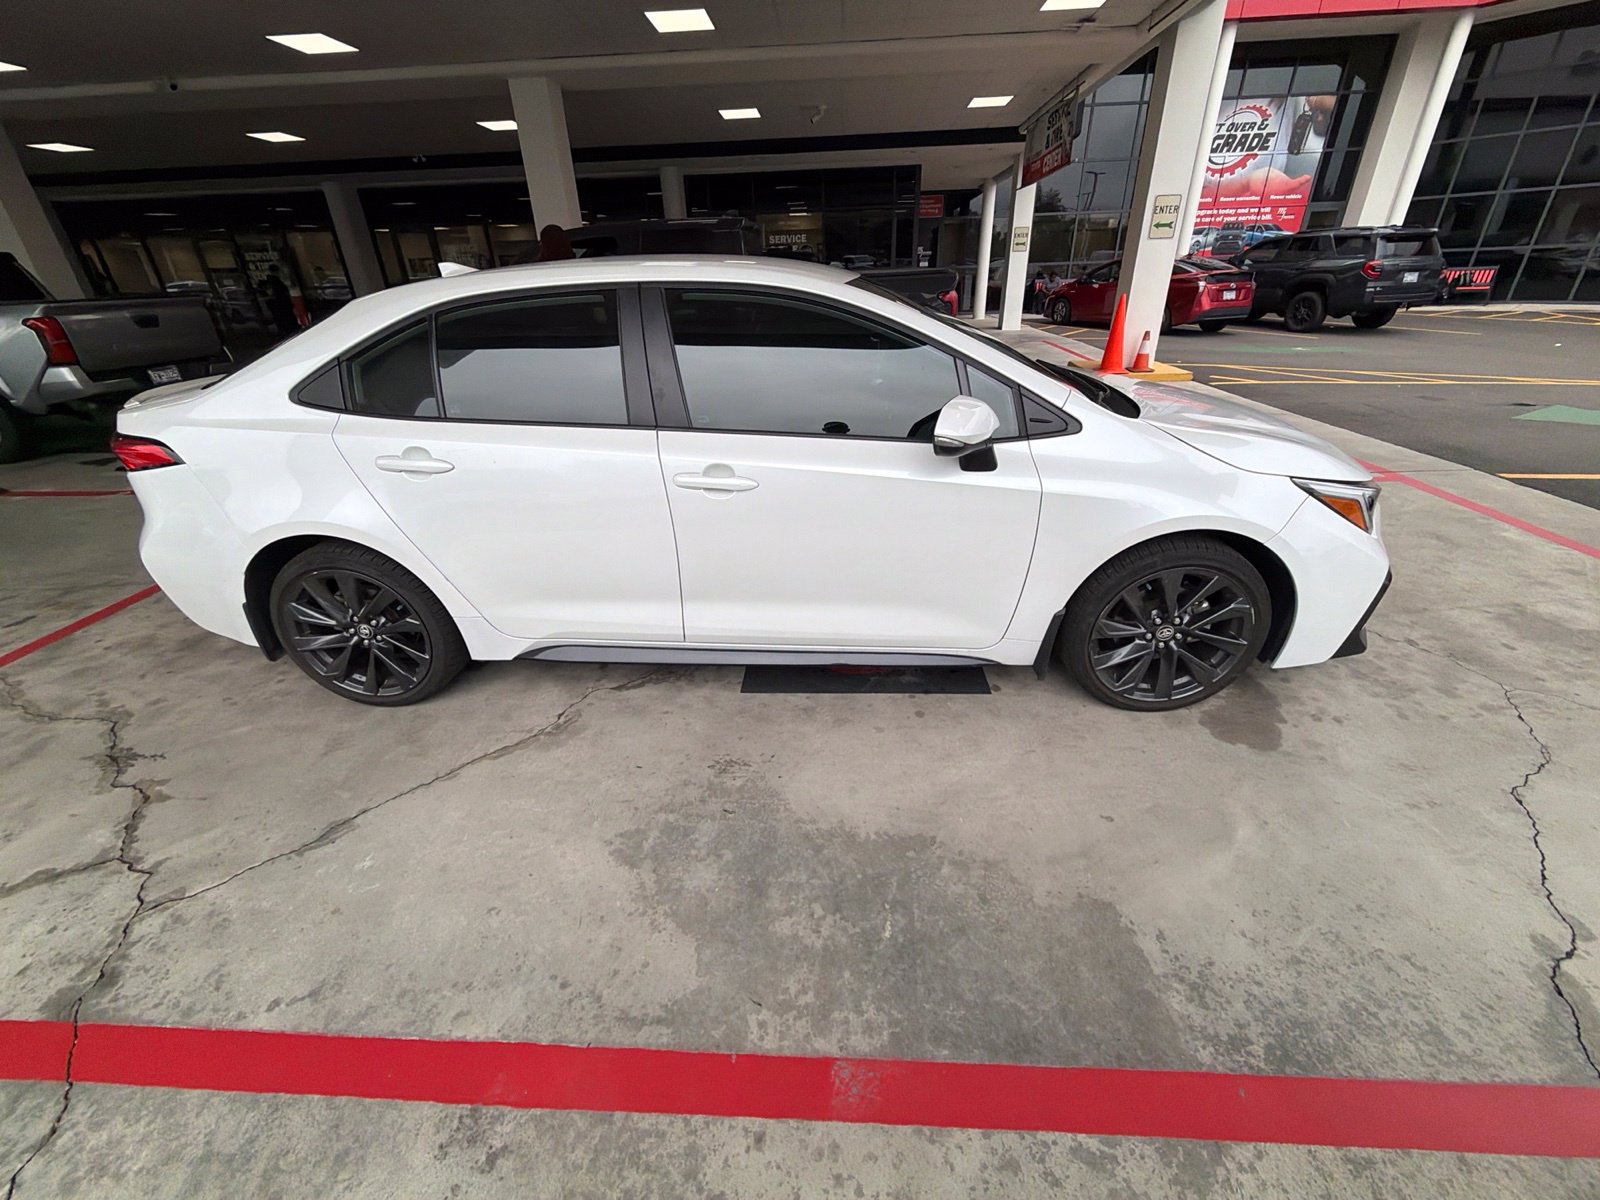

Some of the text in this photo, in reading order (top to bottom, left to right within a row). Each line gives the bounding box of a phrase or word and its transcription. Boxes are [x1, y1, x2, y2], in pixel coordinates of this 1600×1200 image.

[1216, 118, 1270, 133] T OVER &
[1154, 205, 1179, 215] ENTER
[1218, 206, 1237, 215] today
[1223, 216, 1237, 224] your
[769, 234, 807, 244] SERVICE
